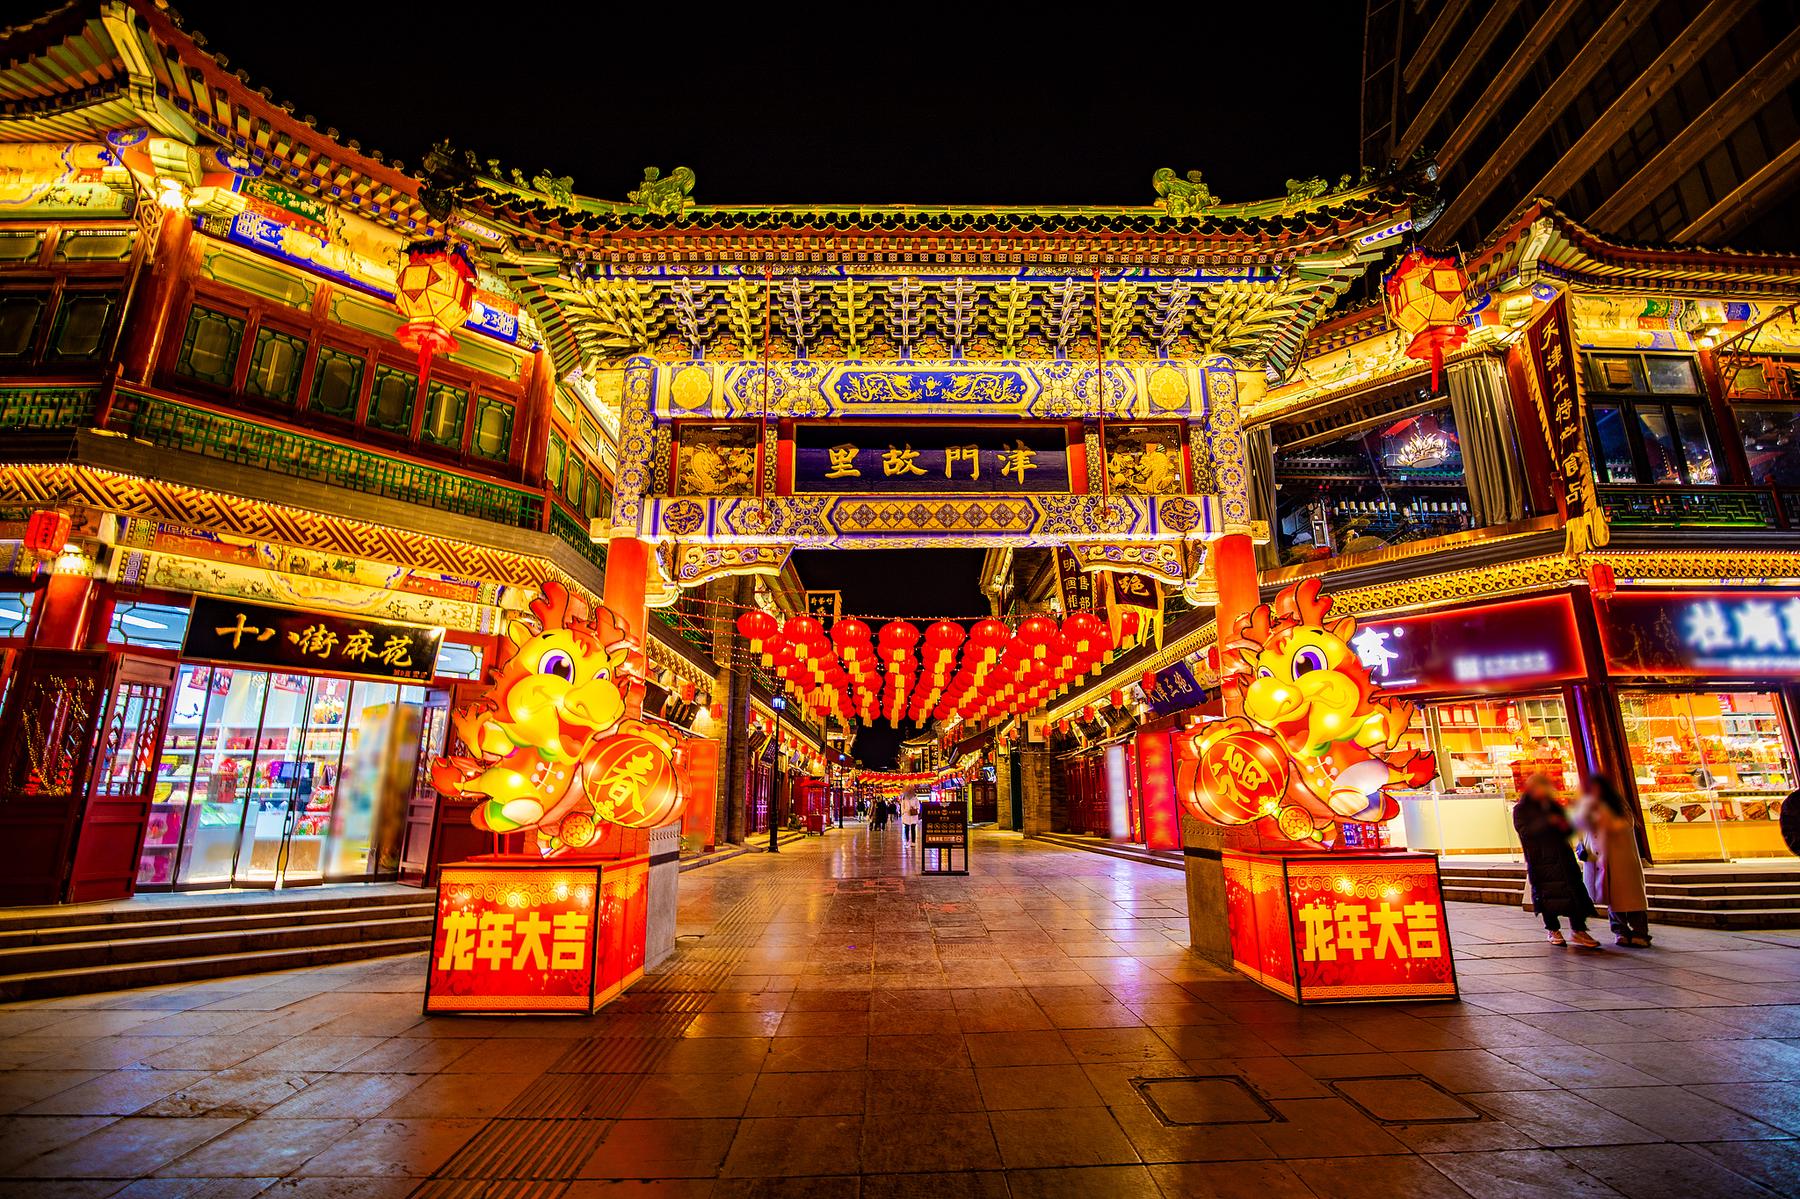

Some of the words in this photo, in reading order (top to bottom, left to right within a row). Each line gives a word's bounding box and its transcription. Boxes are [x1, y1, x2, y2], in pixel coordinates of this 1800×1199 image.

[1061, 548, 1078, 608] 明画框
[215, 613, 413, 666] 十八街麻花
[592, 750, 654, 817] 春
[1211, 745, 1268, 803] 福
[438, 911, 588, 970] 龙年大吉
[1299, 901, 1441, 961] 龙年大吉
